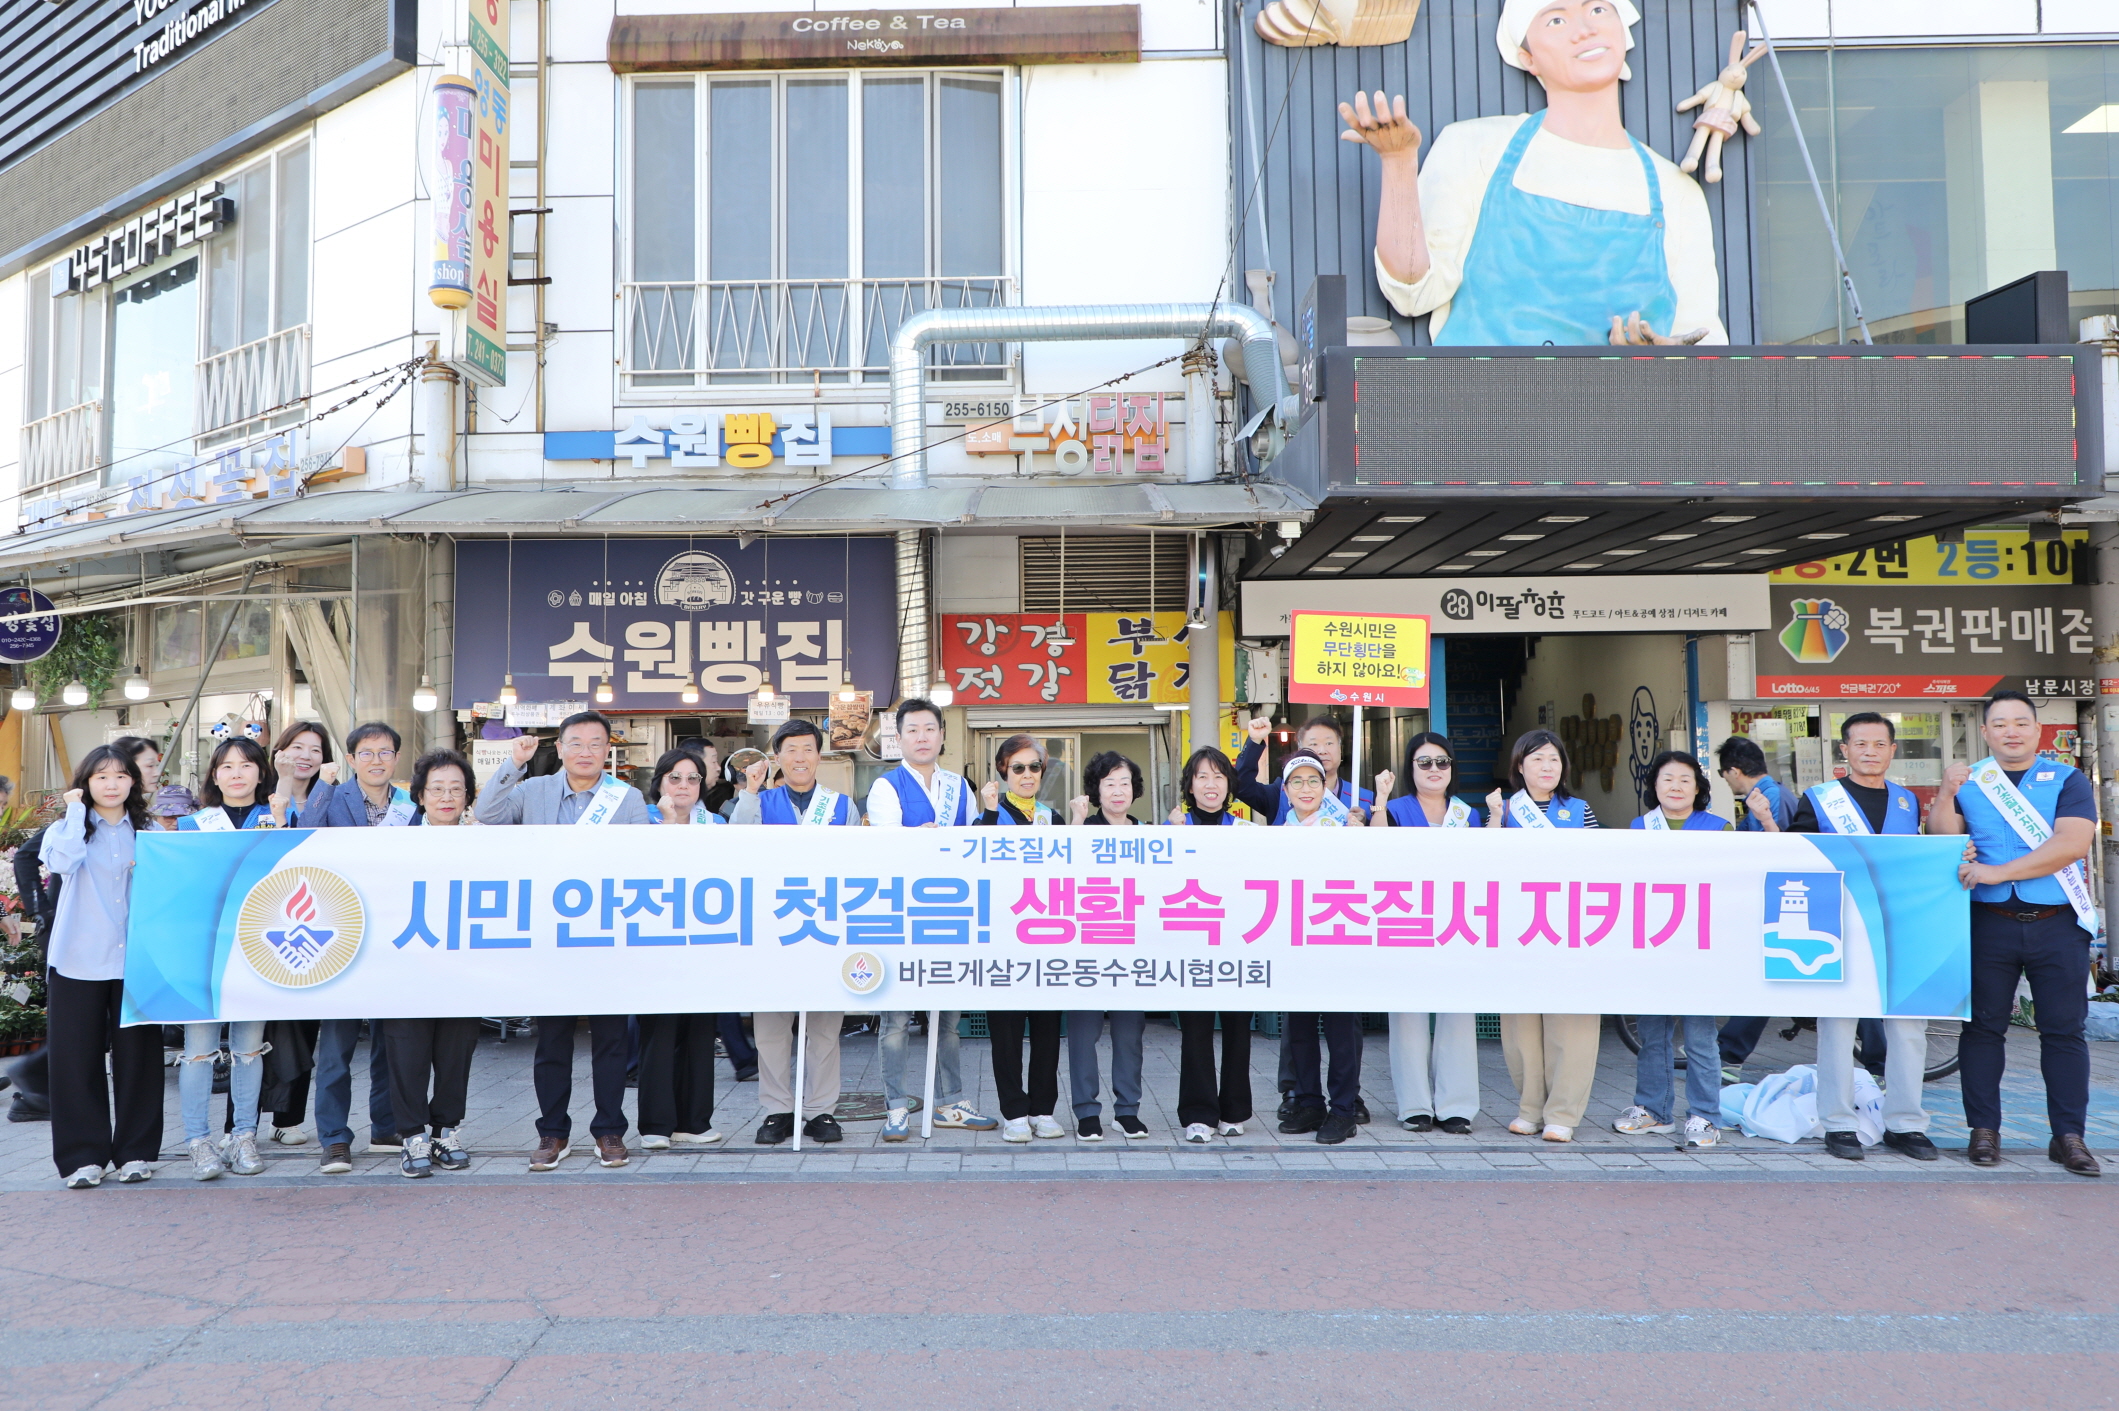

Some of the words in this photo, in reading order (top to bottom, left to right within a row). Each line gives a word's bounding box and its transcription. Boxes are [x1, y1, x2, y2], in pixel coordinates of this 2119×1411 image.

[792, 17, 881, 32] Coffee
[889, 16, 908, 30] &
[917, 15, 966, 29] Tea
[133, 0, 225, 73] Traditional
[474, 67, 507, 135] 영동
[477, 127, 500, 332] 미용실
[490, 355, 505, 377] 0373
[945, 402, 1010, 418] 255-6150
[614, 411, 833, 468] 수원빵집
[588, 592, 616, 606] 매일
[619, 591, 648, 607] 아침
[740, 591, 755, 606] 갓
[757, 590, 786, 606] 구운
[788, 590, 803, 606] 빵
[1573, 609, 1606, 619] 푸드코트
[1615, 608, 1656, 619] 아트&공예
[1659, 608, 1675, 618] 상점
[1323, 621, 1397, 639] 수원시민은
[548, 620, 844, 696] 수원빵집
[1322, 641, 1396, 659] 무단횡단을
[956, 660, 1071, 702] 젓갈
[1317, 661, 1346, 677] 하지
[1352, 662, 1401, 679] 않아요!
[1349, 692, 1385, 703] 수원시
[1922, 684, 1958, 695] 스피또
[2025, 679, 2095, 695] 남문시장
[2018, 814, 2049, 843] 지키기
[962, 837, 1072, 864] 기초질서
[1091, 837, 1173, 864] 캠페인
[391, 880, 532, 950] 시민
[553, 876, 754, 947] 안전의
[773, 876, 991, 946] 첫걸음!
[1010, 877, 1145, 945] 생활
[1158, 879, 1226, 946] 속
[1242, 879, 1501, 949] 기초질서
[1518, 881, 1711, 949] 지키기
[899, 958, 1272, 988] 바르게살기운동수원시협의회
